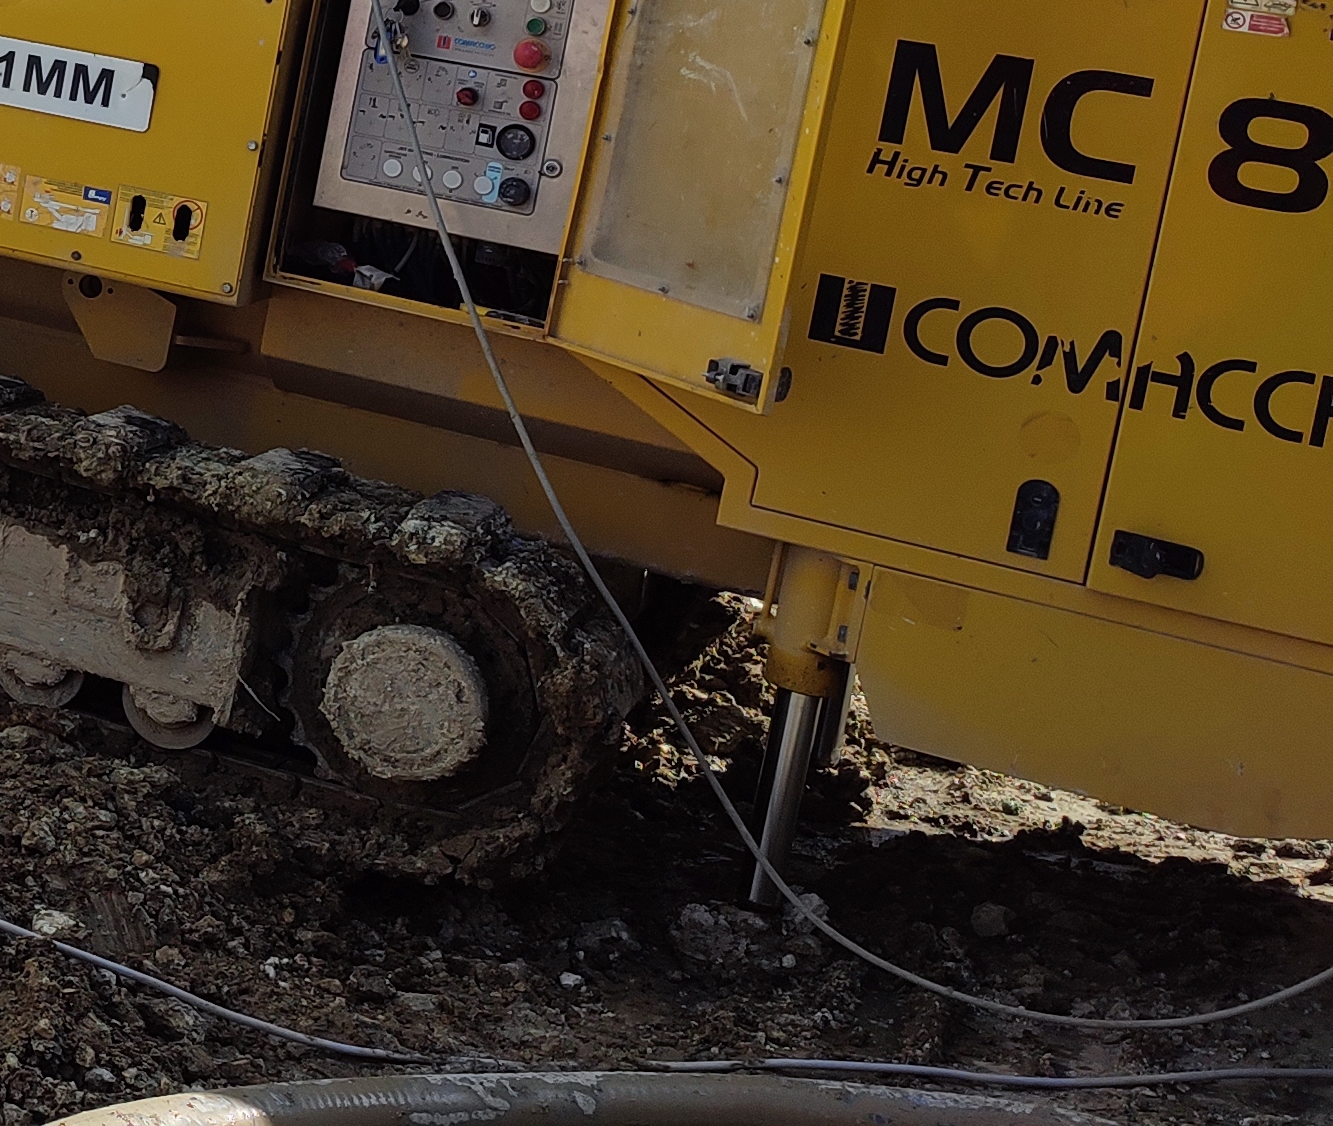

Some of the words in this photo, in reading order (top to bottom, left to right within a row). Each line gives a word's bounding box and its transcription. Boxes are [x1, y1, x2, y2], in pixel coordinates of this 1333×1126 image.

[866, 148, 948, 187] High
[963, 163, 1043, 205] Tech
[1054, 189, 1125, 219] Line
[878, 39, 1154, 185] MC
[1208, 97, 1333, 213] 8
